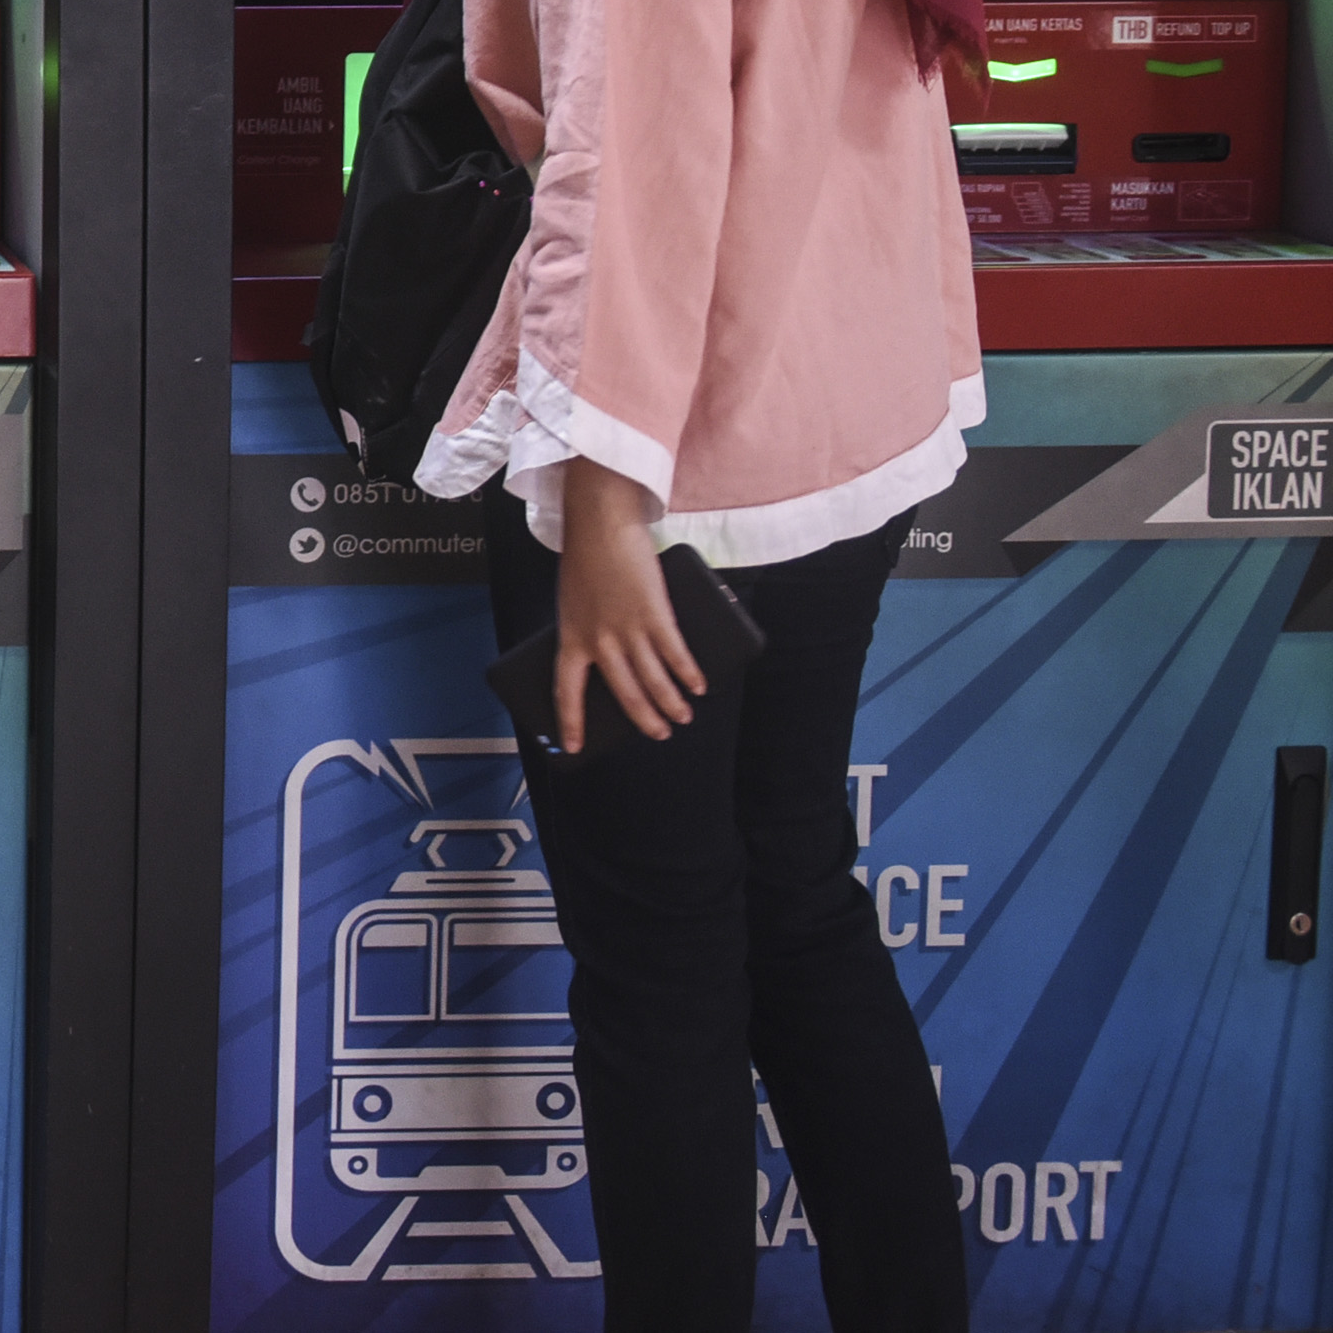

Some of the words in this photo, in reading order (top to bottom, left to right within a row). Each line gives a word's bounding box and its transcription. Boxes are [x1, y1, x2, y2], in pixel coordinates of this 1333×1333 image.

[1006, 18, 1037, 32] UANG
[1041, 18, 1083, 32] KERTAS
[1117, 20, 1149, 40] THB
[1155, 23, 1201, 36] REFUND
[1211, 23, 1232, 36] TOP
[1235, 23, 1251, 36] UP
[1110, 182, 1175, 196] MASUKKAN
[1110, 197, 1147, 211] KARTU
[1231, 429, 1329, 468] SPACE
[1234, 472, 1323, 511] IKLAN
